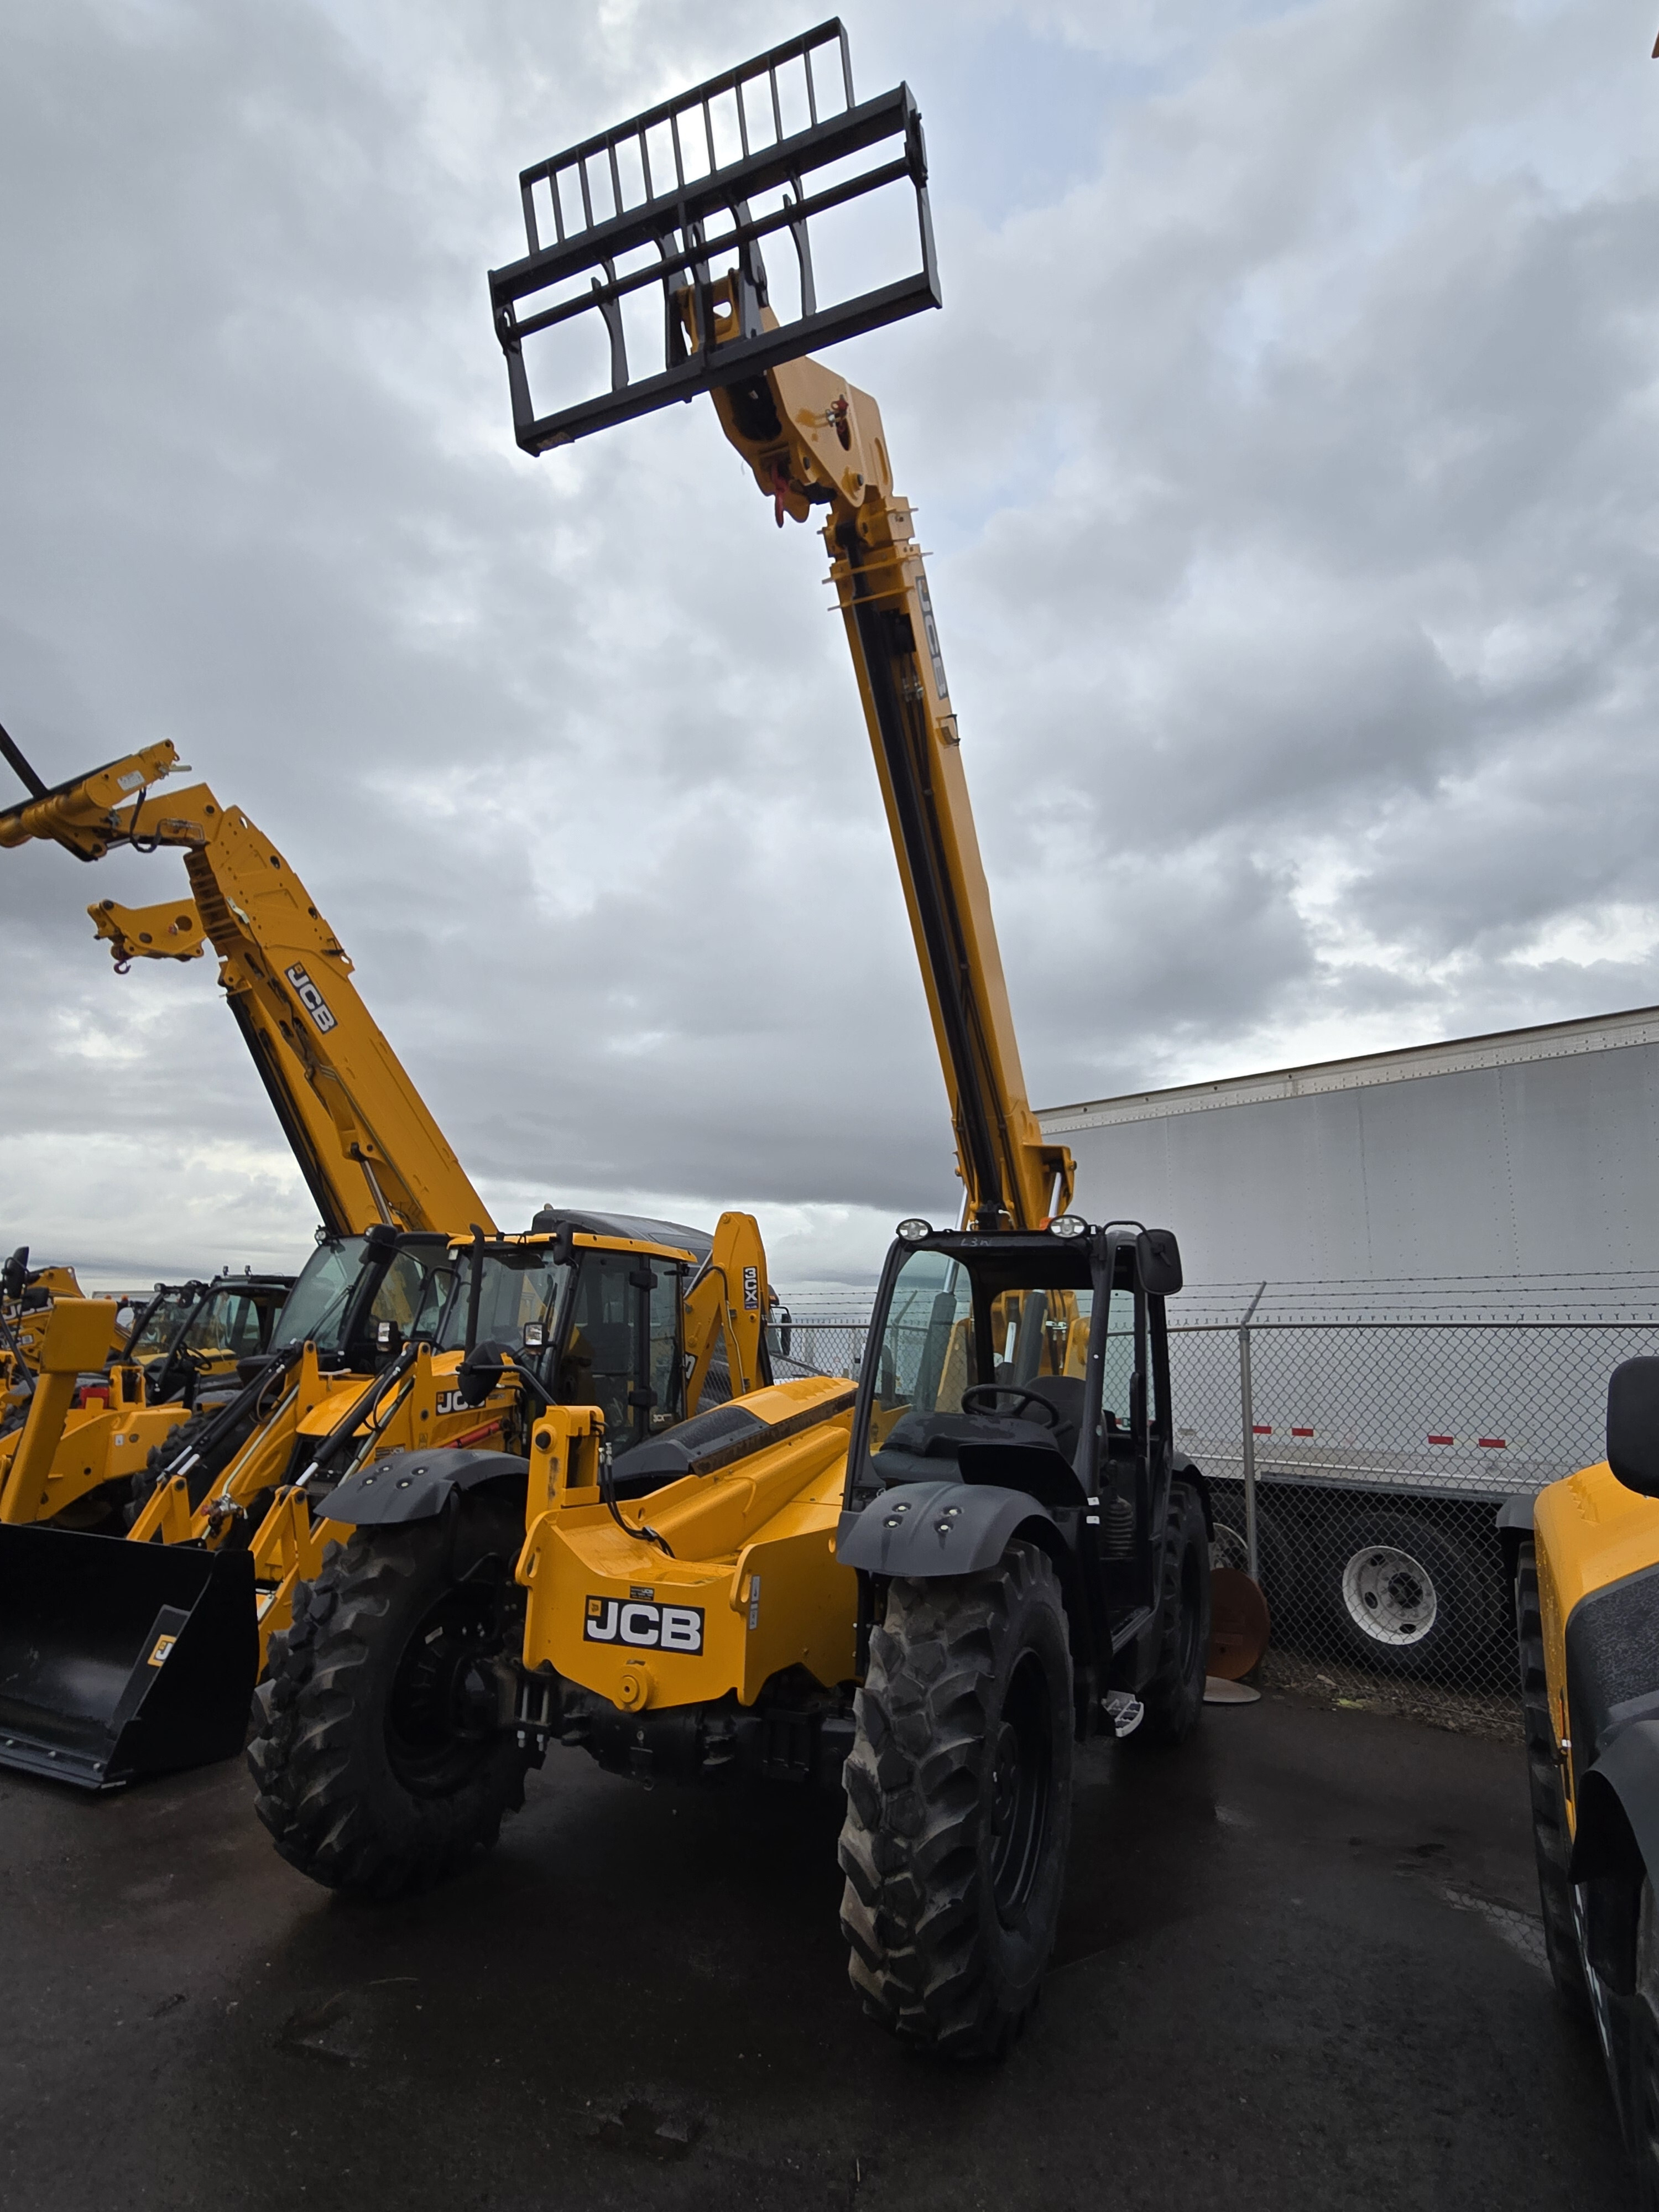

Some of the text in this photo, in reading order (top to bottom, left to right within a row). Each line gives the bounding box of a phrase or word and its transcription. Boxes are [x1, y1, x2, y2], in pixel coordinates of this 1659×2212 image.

[288, 968, 335, 1032] JCB
[745, 1267, 758, 1302] 3CX
[437, 1390, 486, 1414] JC
[587, 1601, 701, 1651] JCB
